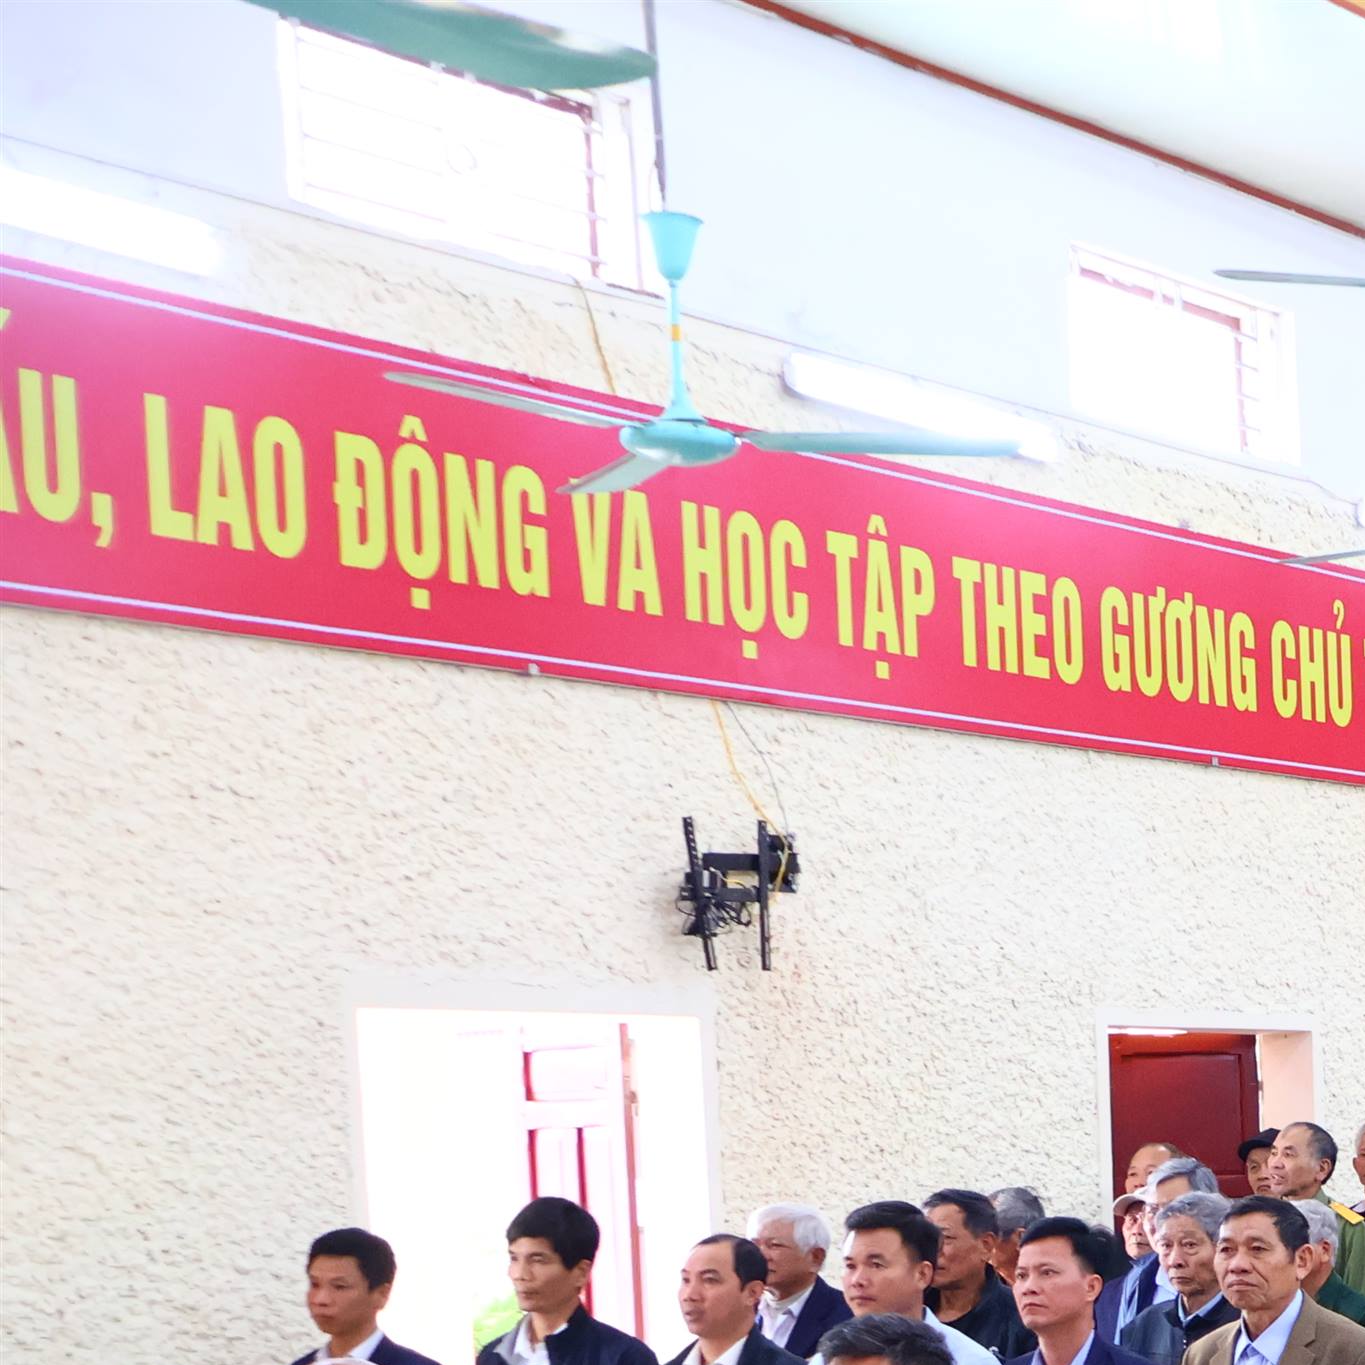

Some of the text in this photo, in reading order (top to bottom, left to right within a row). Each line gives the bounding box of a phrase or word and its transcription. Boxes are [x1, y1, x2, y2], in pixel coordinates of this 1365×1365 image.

[144, 393, 307, 559] LAO
[333, 415, 549, 610] ĐỘNG
[682, 501, 808, 658] HỌC
[826, 514, 935, 678] TẬP
[954, 557, 1083, 684] THEO
[1100, 586, 1257, 711] GƯƠNG
[1271, 600, 1352, 727] CHỦ
